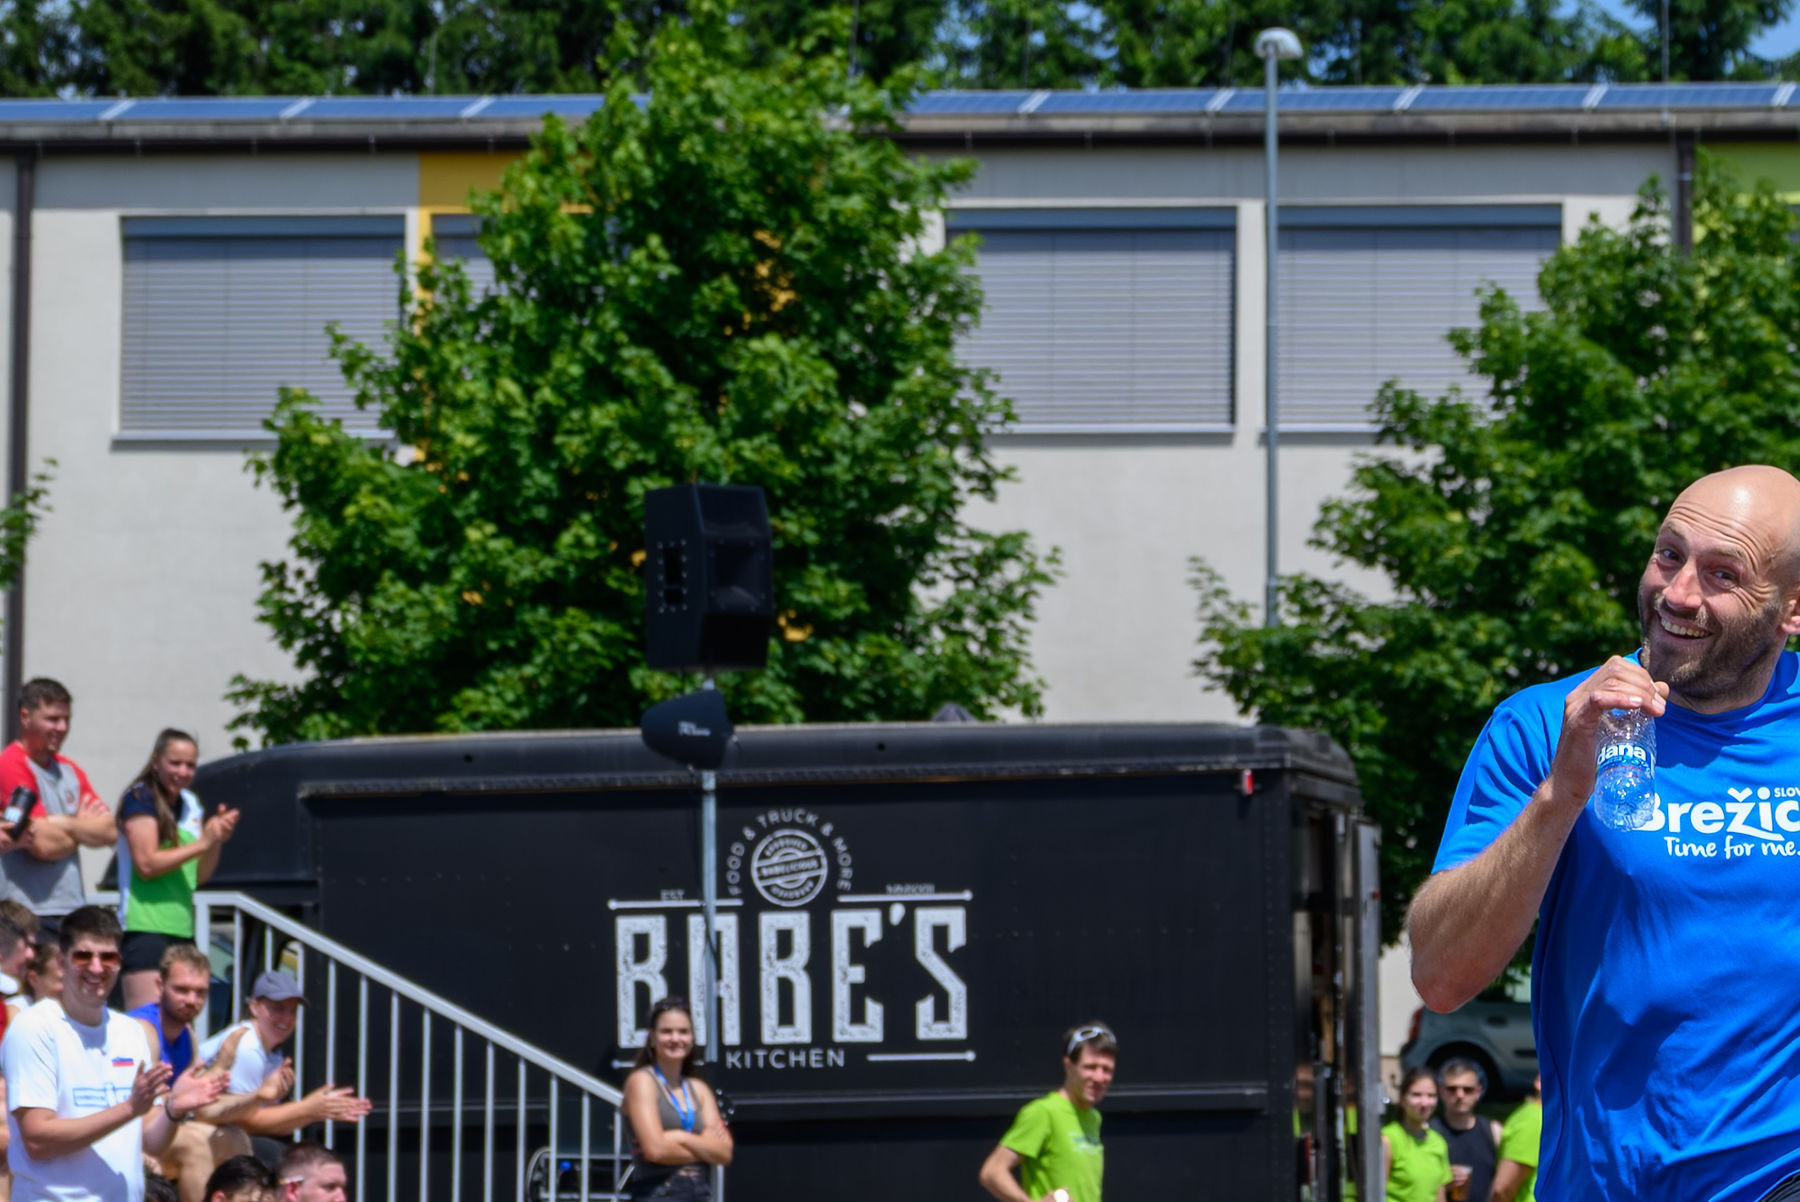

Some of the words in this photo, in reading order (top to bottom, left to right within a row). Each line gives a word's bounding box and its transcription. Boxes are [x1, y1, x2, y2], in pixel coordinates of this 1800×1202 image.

[726, 842, 745, 895] FOOD
[742, 826, 756, 840] &
[756, 808, 819, 828] TRUCK
[820, 822, 834, 837] &
[833, 837, 853, 891] MORE
[1664, 836, 1717, 858] Time
[1724, 835, 1754, 859] for
[615, 907, 967, 1048] BABE'S
[726, 1049, 845, 1069] KITCHEN
